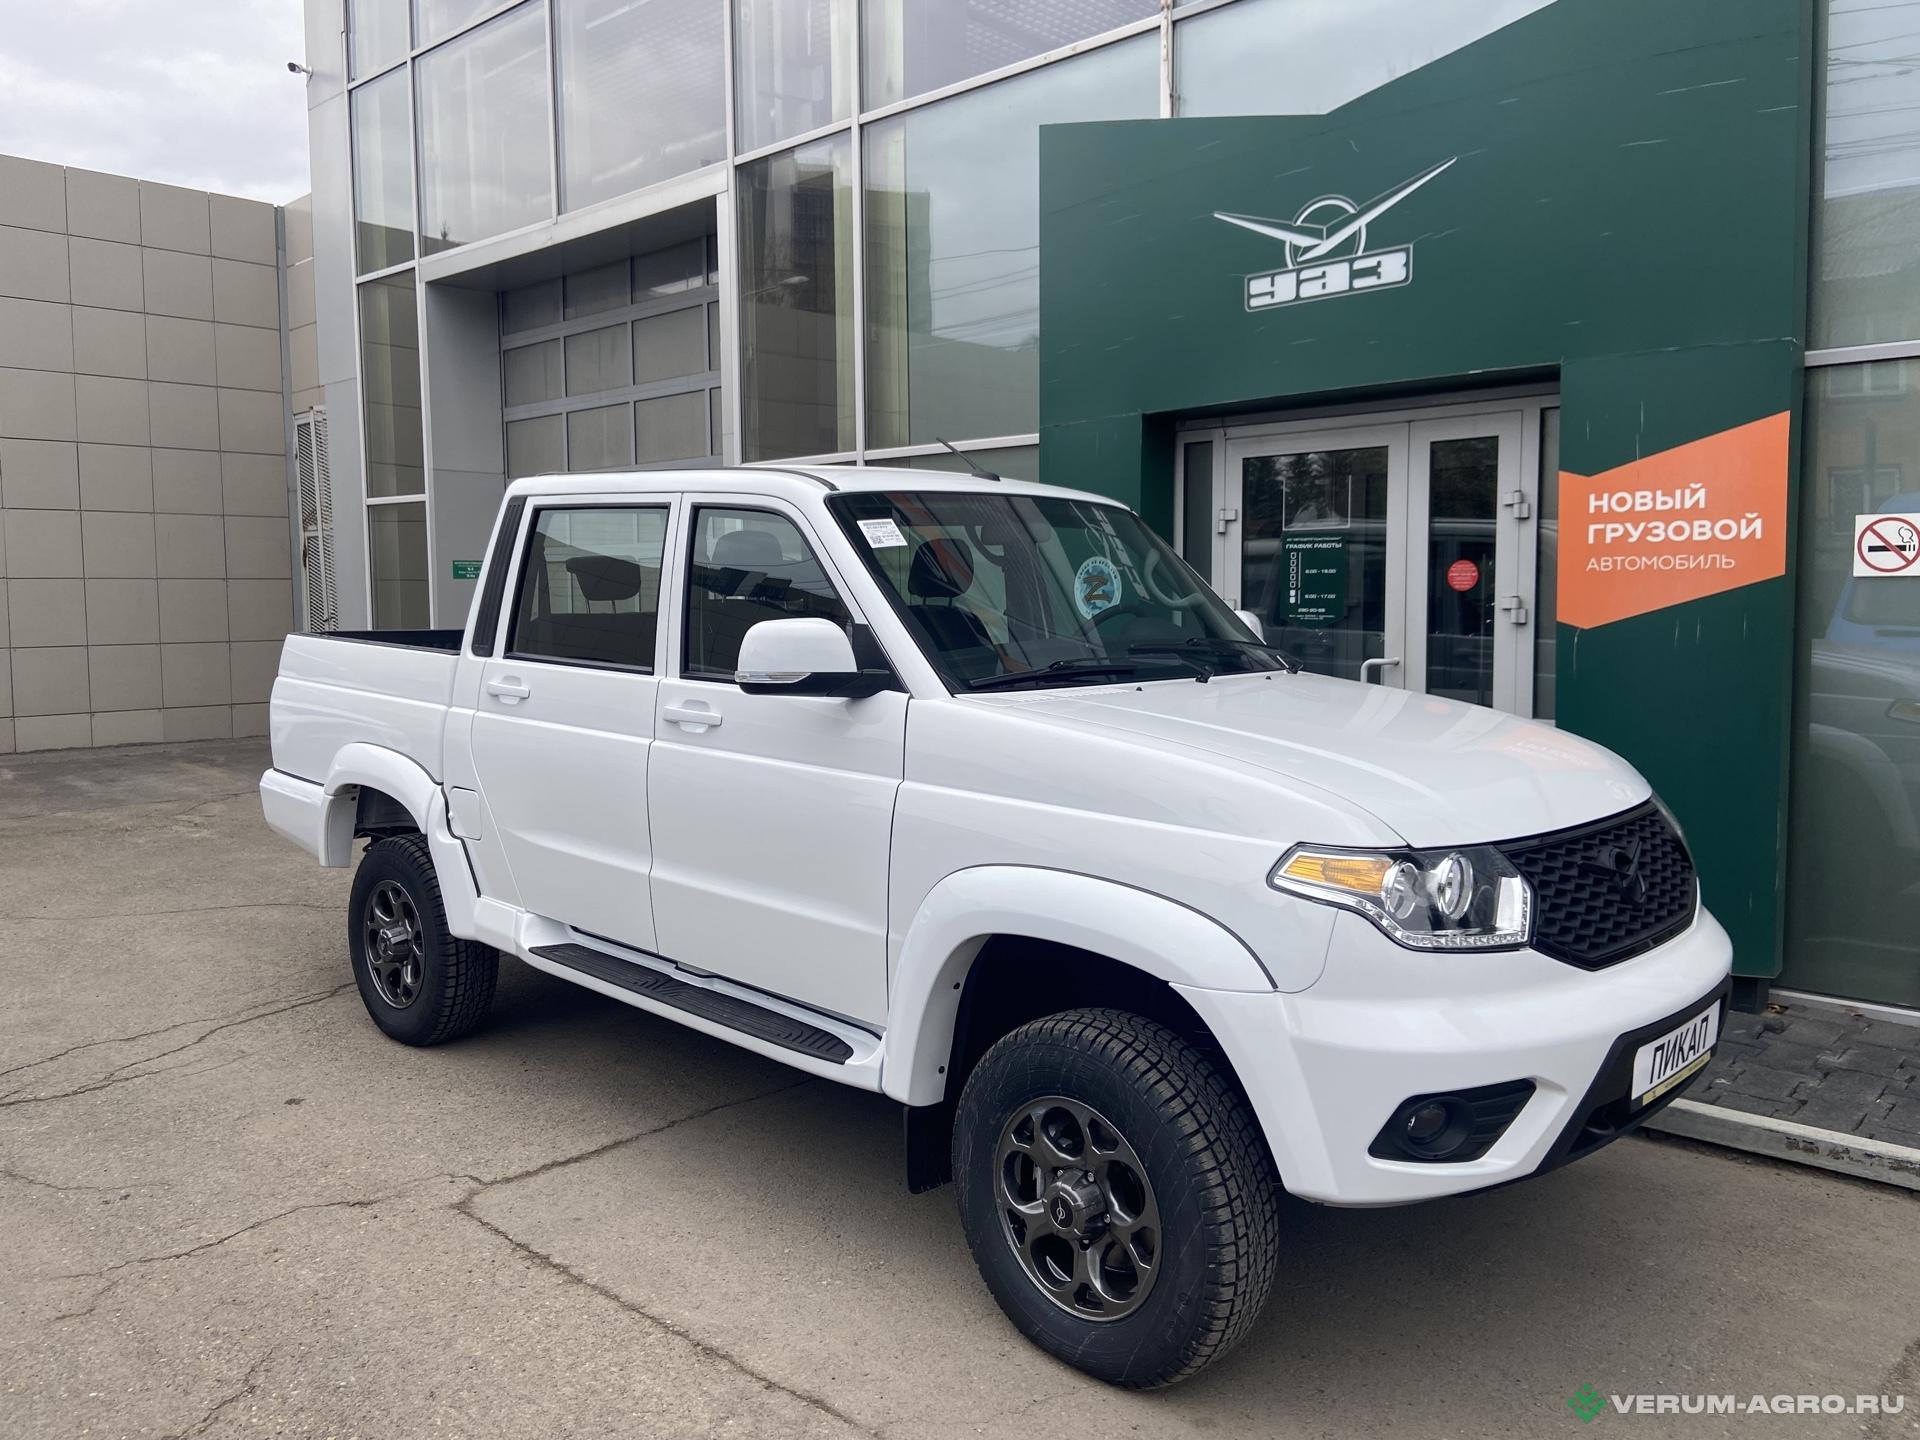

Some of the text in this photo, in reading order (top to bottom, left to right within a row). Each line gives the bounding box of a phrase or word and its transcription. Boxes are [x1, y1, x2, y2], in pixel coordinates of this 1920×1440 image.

[1588, 482, 1707, 514] НОВЫЙ
[1587, 512, 1763, 545] ГРУЗОВОЙ
[1586, 553, 1736, 572] АВТОМОБИЛЬ
[1649, 1013, 1710, 1085] ПИКАП
